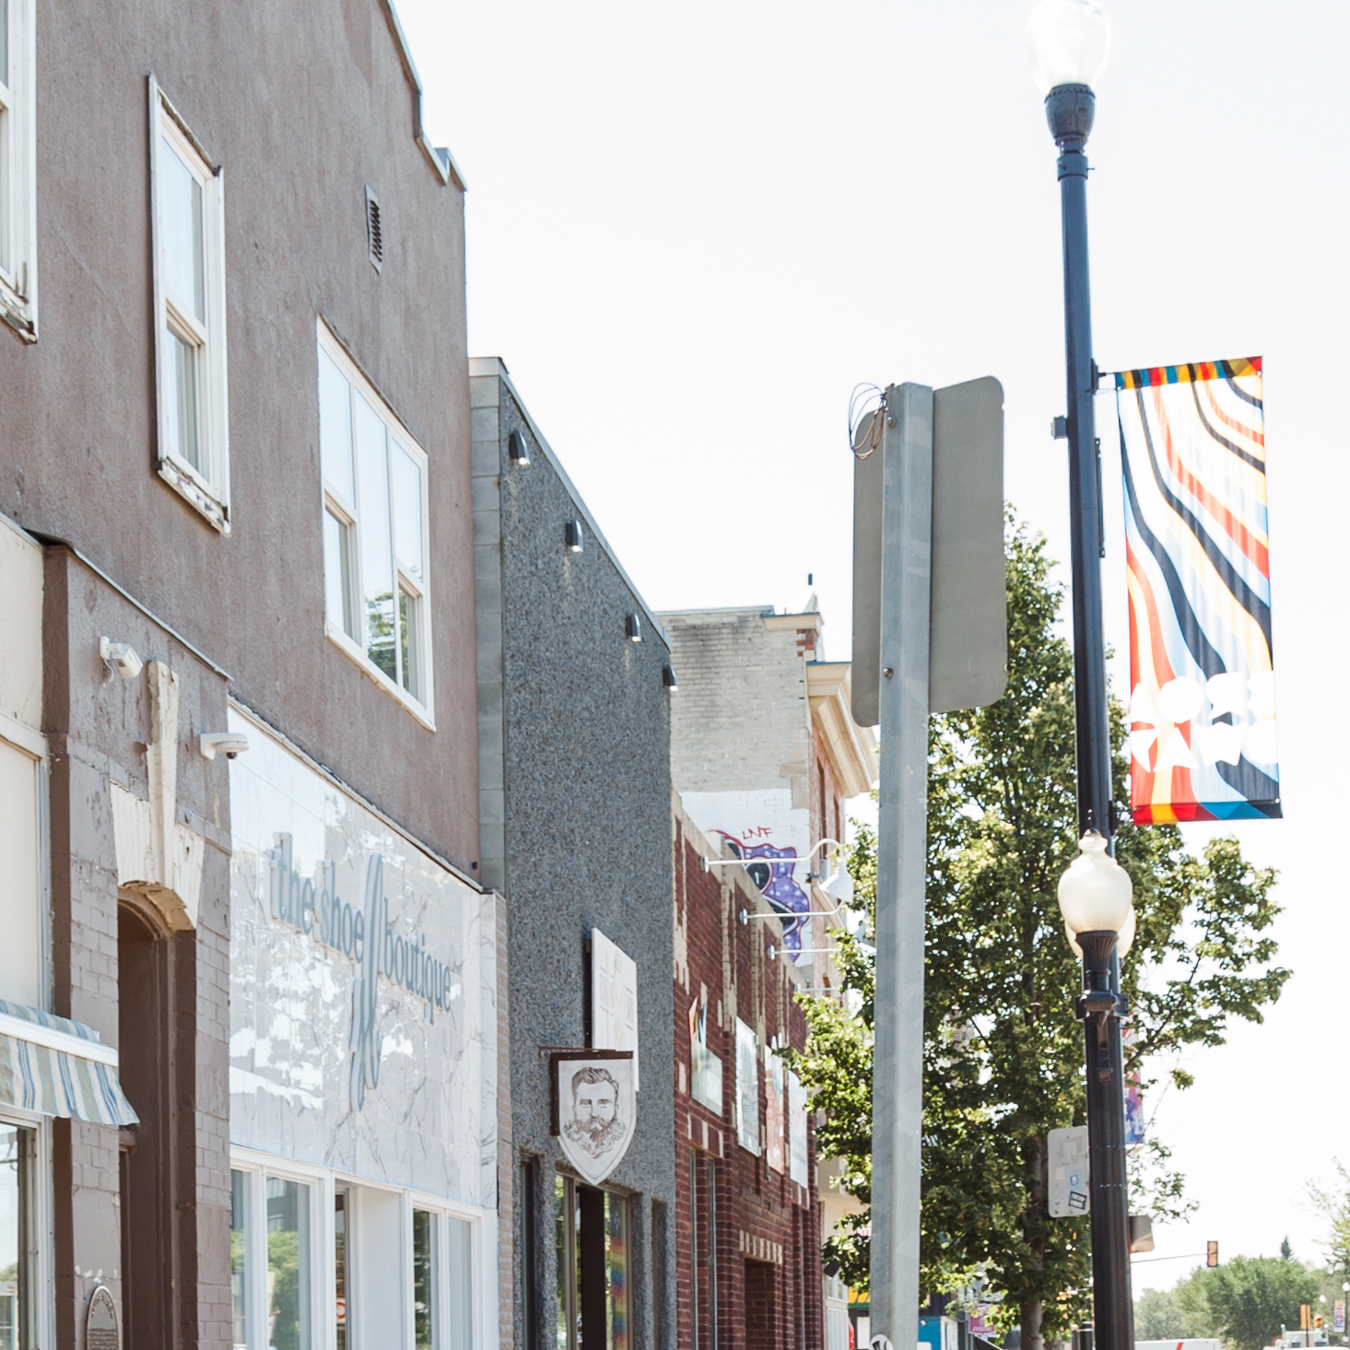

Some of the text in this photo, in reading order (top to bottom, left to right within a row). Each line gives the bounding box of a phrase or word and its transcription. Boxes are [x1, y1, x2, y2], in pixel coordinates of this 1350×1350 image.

[265, 831, 452, 1026] the shoe boutique
